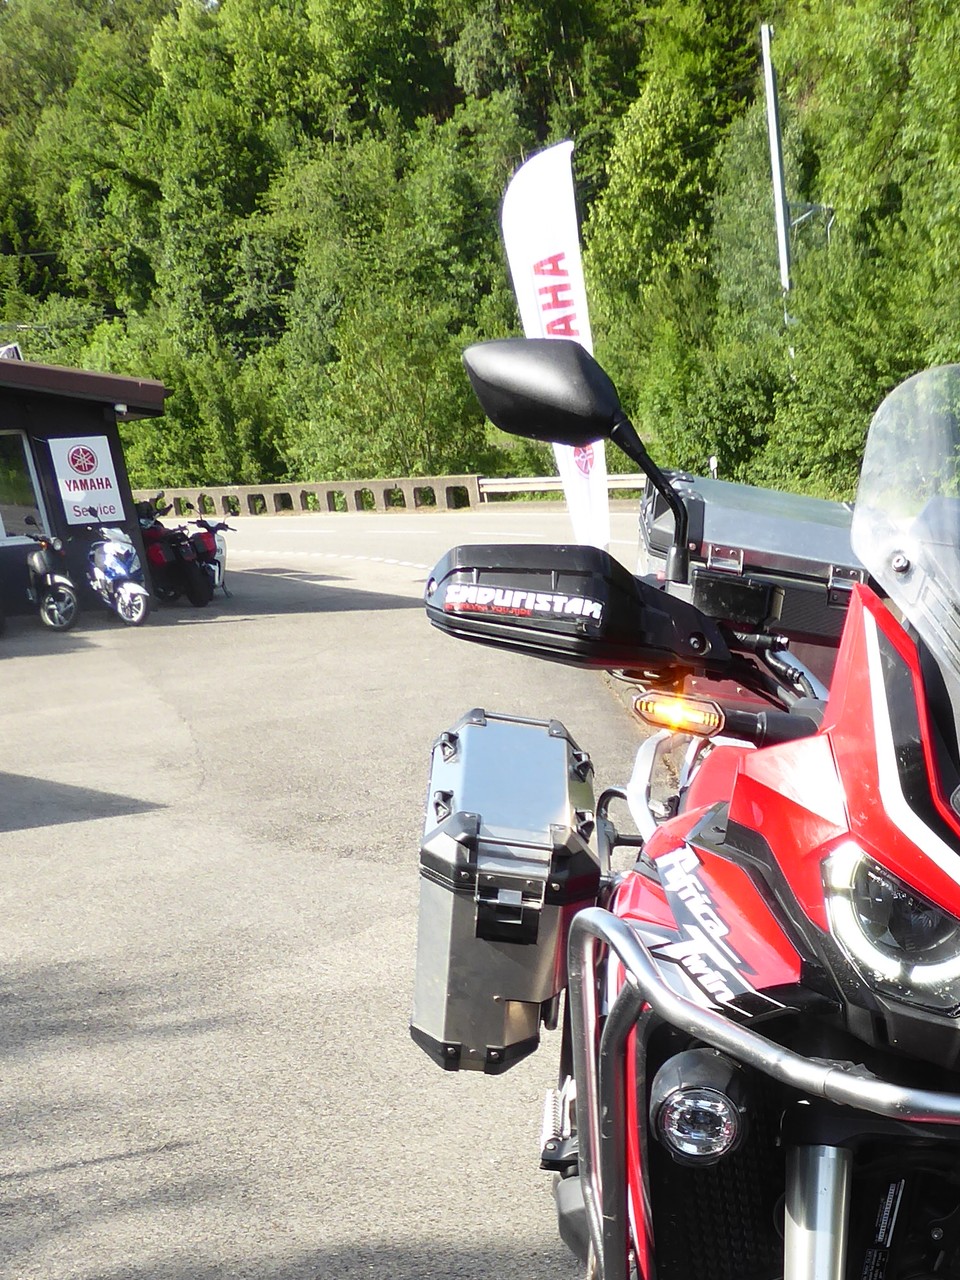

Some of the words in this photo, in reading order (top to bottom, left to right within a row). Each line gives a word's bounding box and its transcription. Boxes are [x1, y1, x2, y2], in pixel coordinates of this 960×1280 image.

[532, 251, 580, 338] AHA
[65, 477, 113, 492] YAMAHA
[72, 504, 116, 517] Seice
[446, 584, 603, 620] ENDURISTAN
[655, 843, 738, 950] Africa
[655, 924, 758, 1006] Twin
